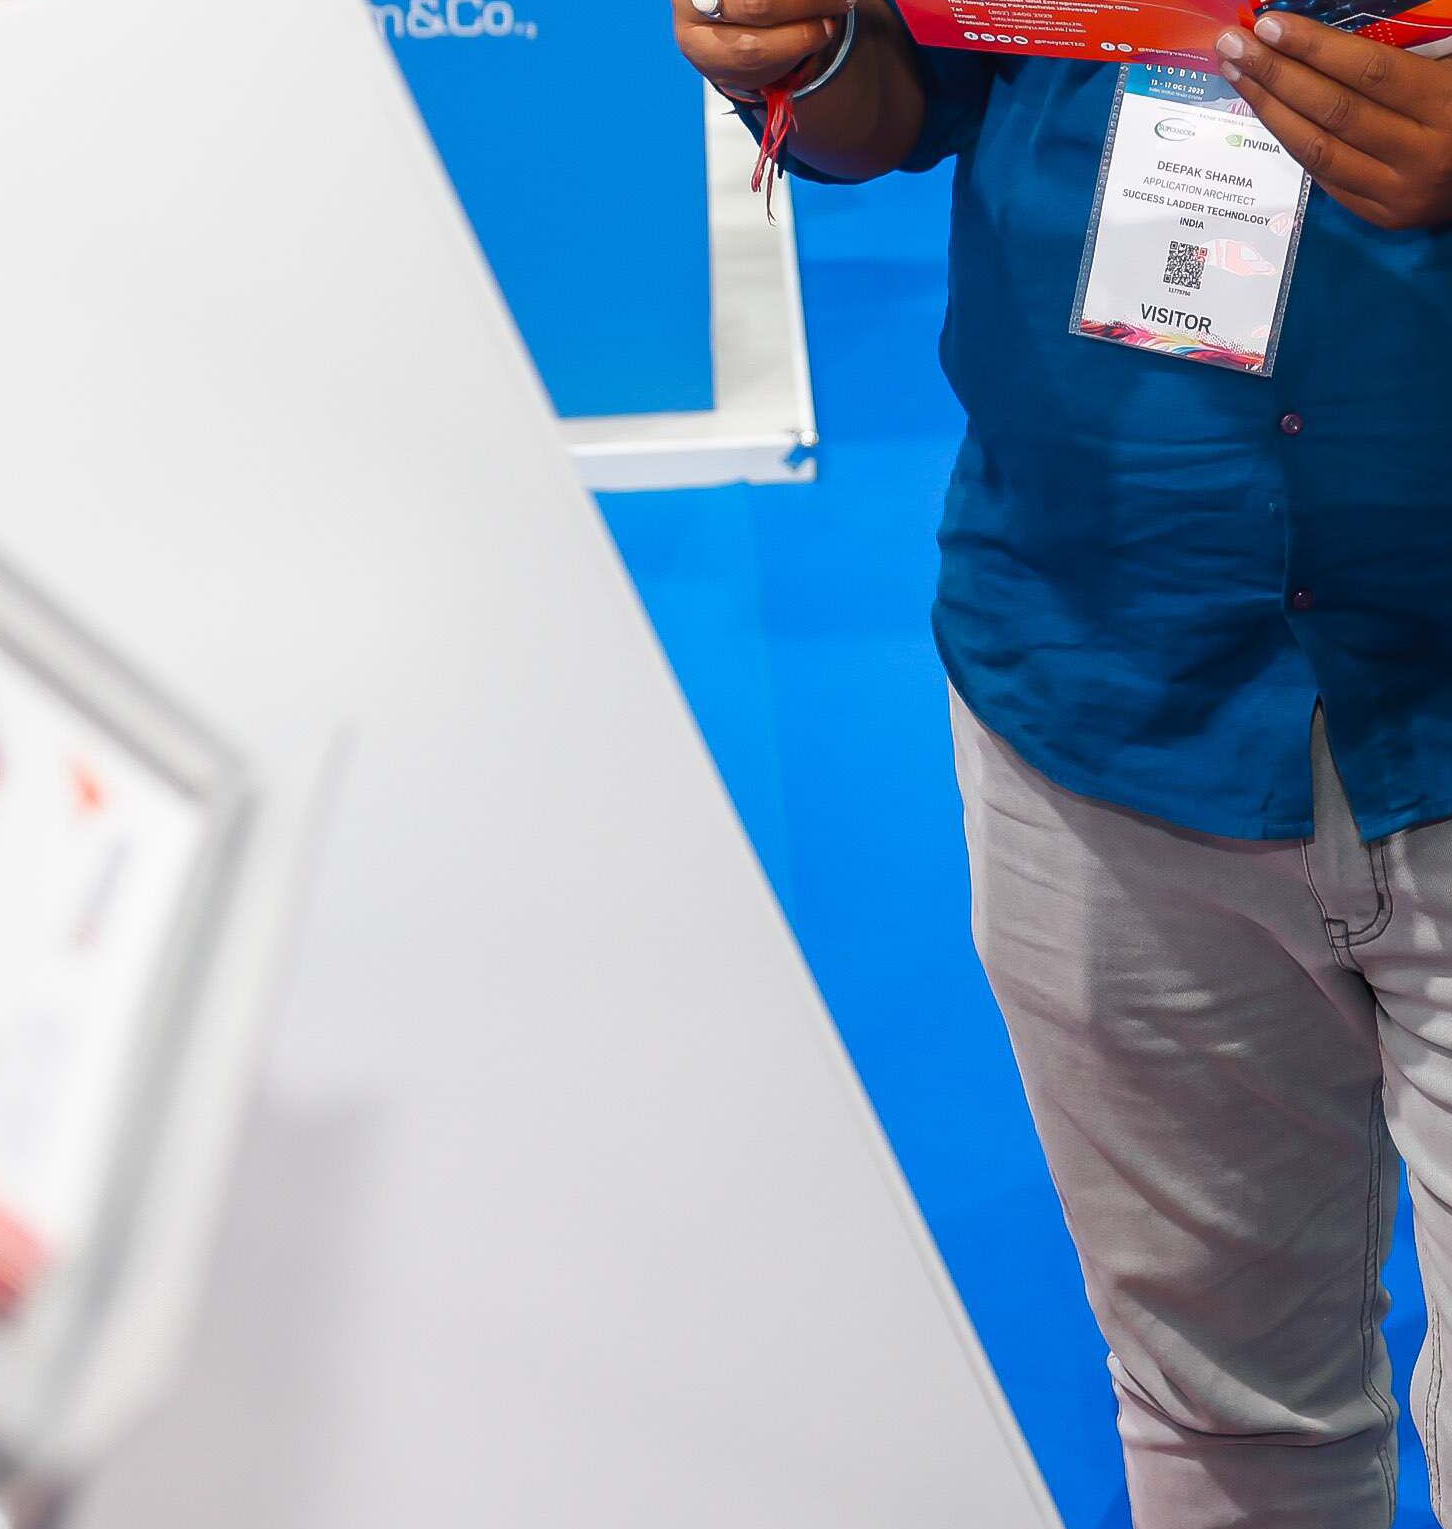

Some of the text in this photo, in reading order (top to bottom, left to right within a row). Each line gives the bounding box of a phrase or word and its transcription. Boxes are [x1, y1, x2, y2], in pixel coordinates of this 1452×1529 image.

[1172, 83, 1186, 91] OCT
[1186, 85, 1205, 95] 2025
[1157, 160, 1254, 189] DEEPAK SHARMA
[1142, 176, 1257, 207] APPLICATION ARCHITECT
[1122, 188, 1271, 226] SUCCESS LADDER TECHNOLOGY
[1179, 216, 1205, 230] INDIA
[1140, 303, 1213, 334] VISITOR
